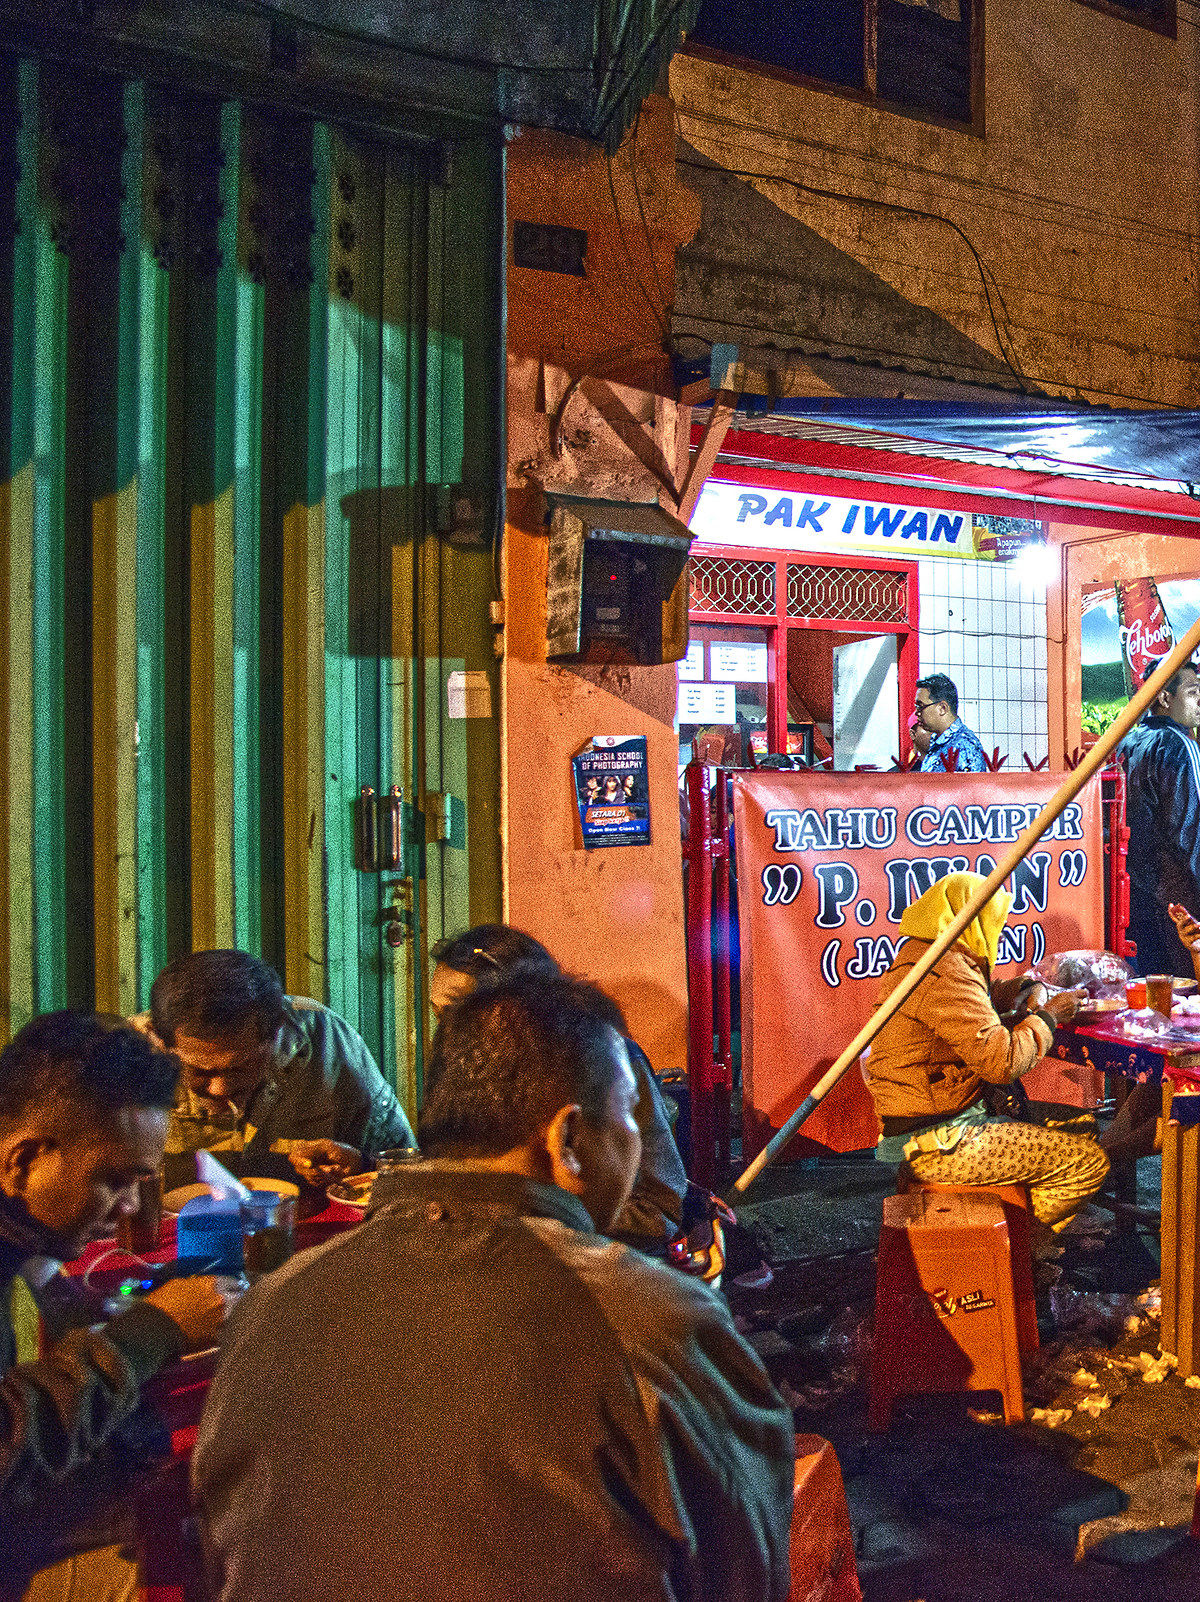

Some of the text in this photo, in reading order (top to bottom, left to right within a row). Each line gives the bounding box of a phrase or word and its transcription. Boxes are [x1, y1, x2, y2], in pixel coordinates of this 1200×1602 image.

[736, 493, 964, 543] PAK IWAN
[582, 760, 643, 770] OF PHOTOGRAPHY
[617, 751, 643, 761] SCHOOL
[765, 808, 897, 852] TAHU
